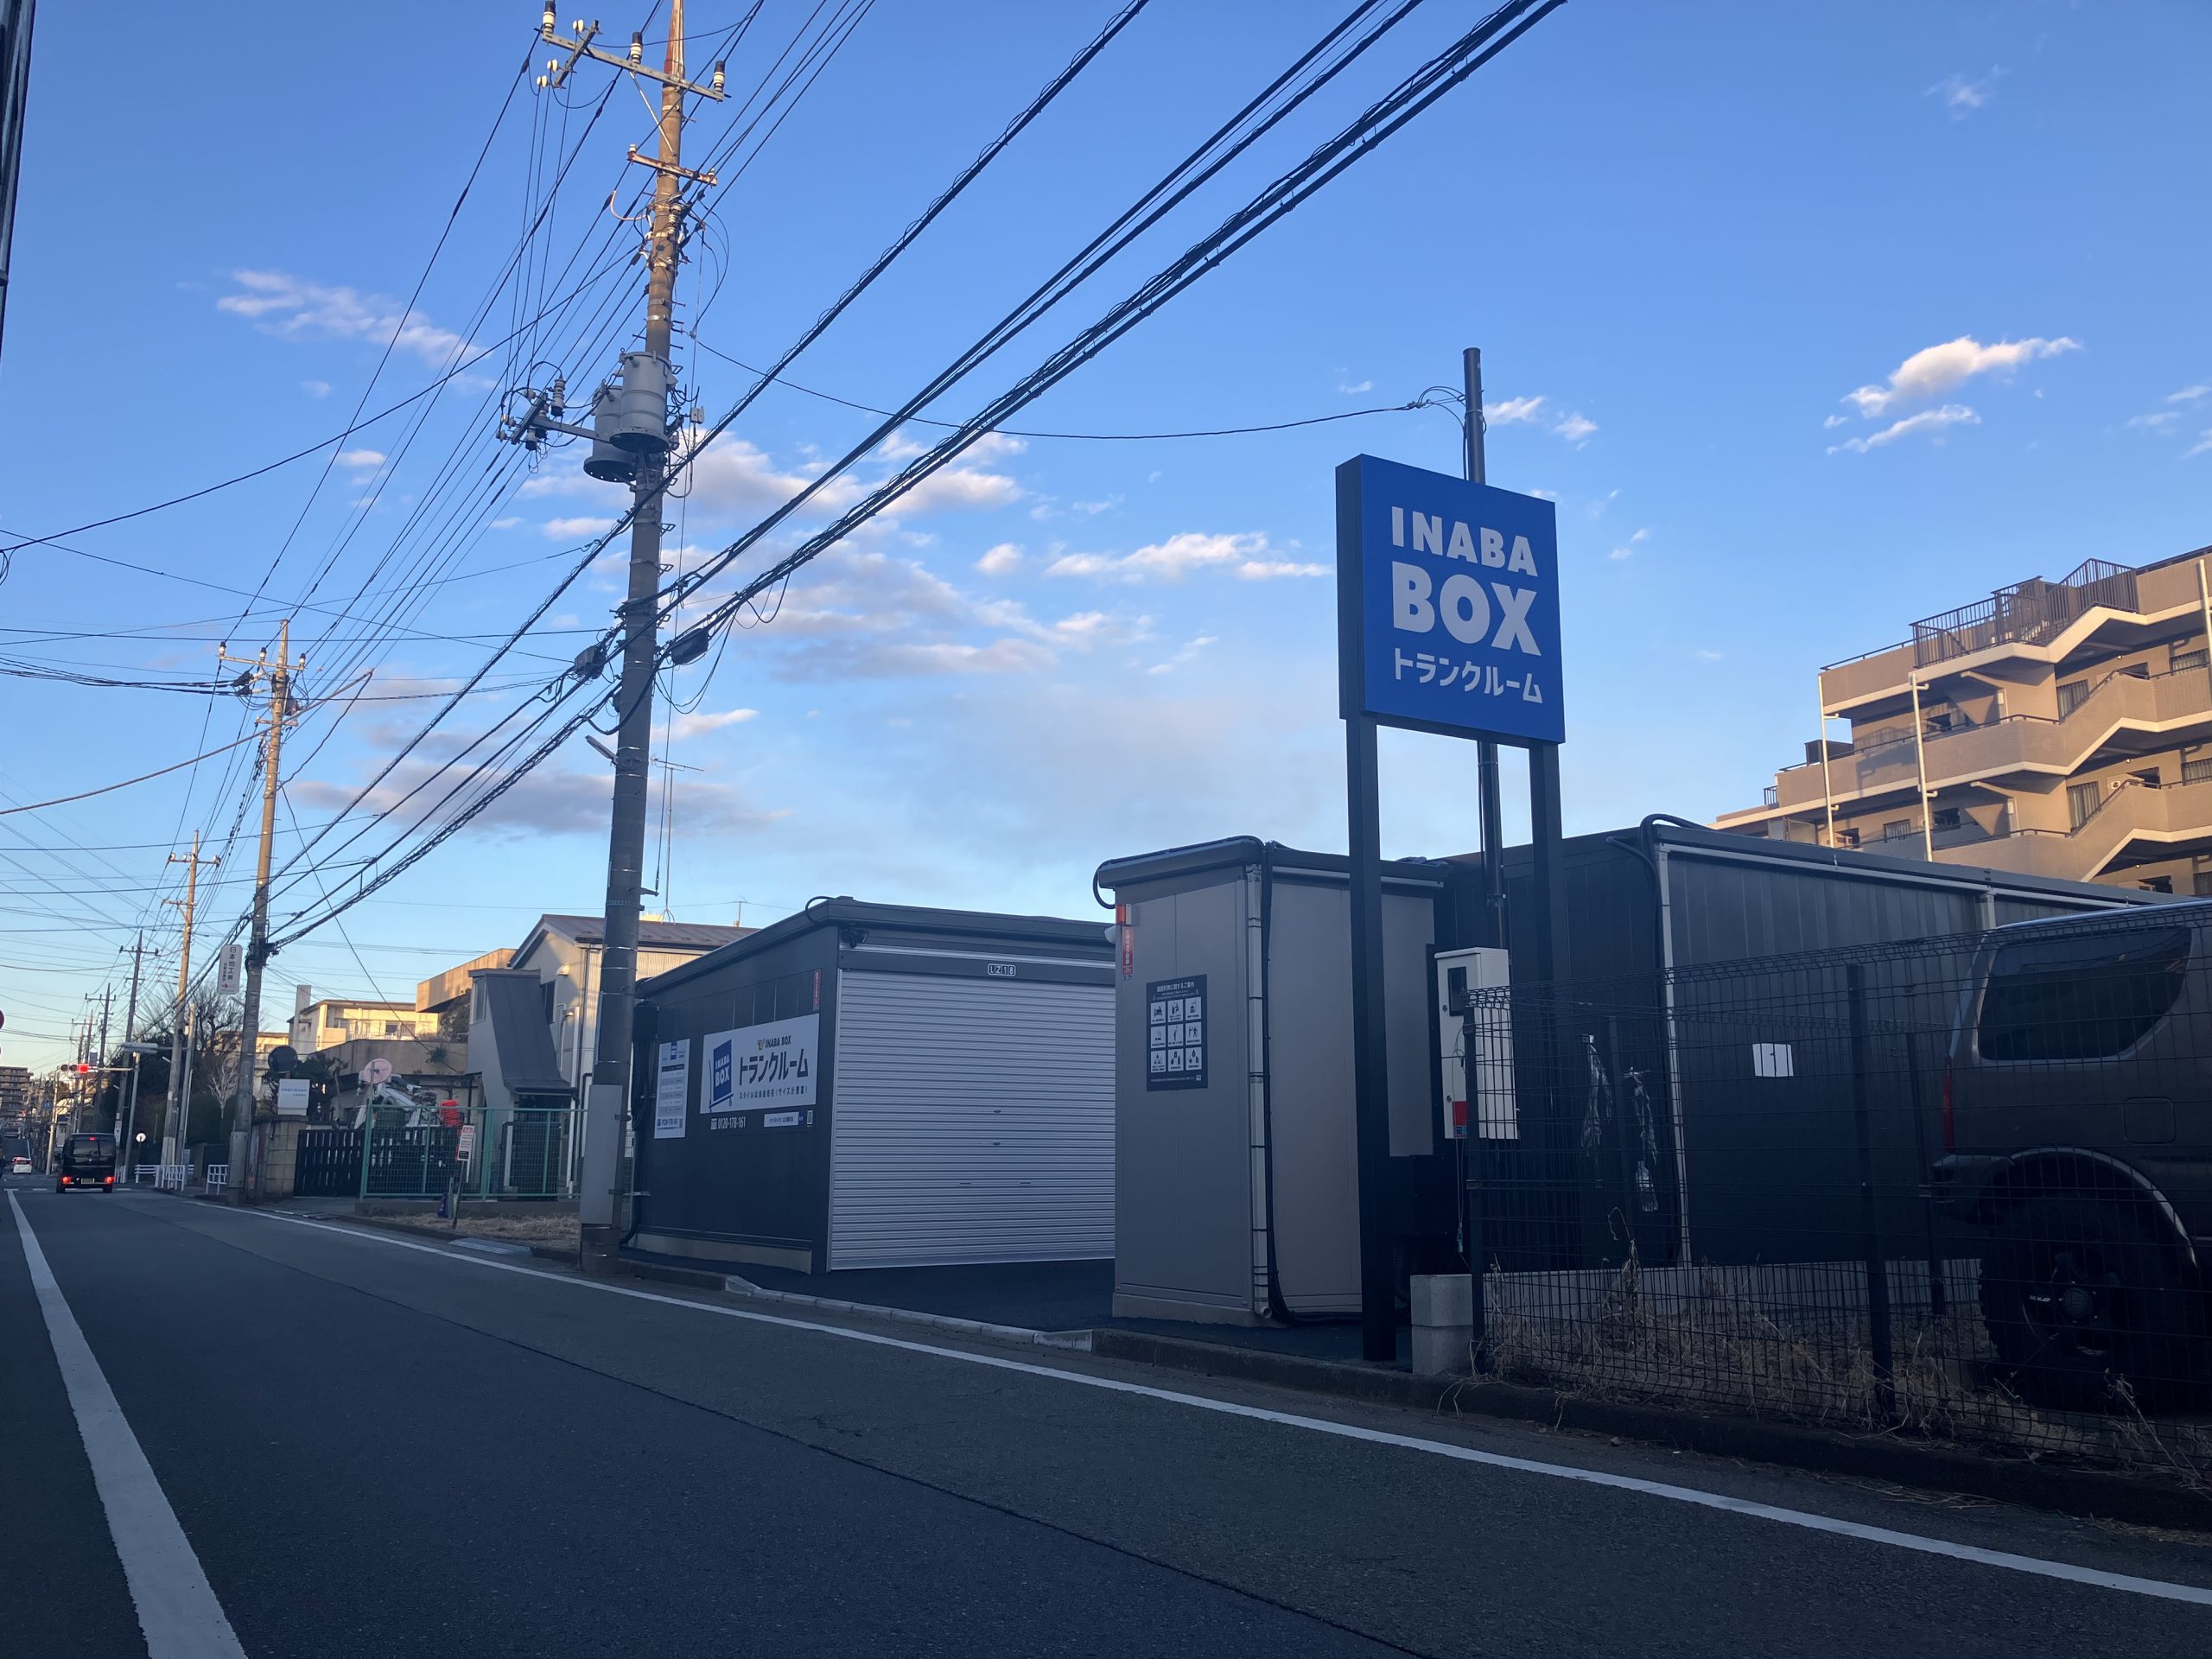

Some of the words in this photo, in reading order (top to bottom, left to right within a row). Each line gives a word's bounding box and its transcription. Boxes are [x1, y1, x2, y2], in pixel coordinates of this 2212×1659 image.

[1392, 506, 1538, 577] INABA
[1392, 561, 1541, 657] BOX
[1395, 648, 1543, 704] トランクルーム
[765, 1037, 780, 1048] INABA
[715, 1054, 730, 1071] INABA
[715, 1065, 730, 1088] BOX
[740, 1048, 809, 1085] トランクルーム
